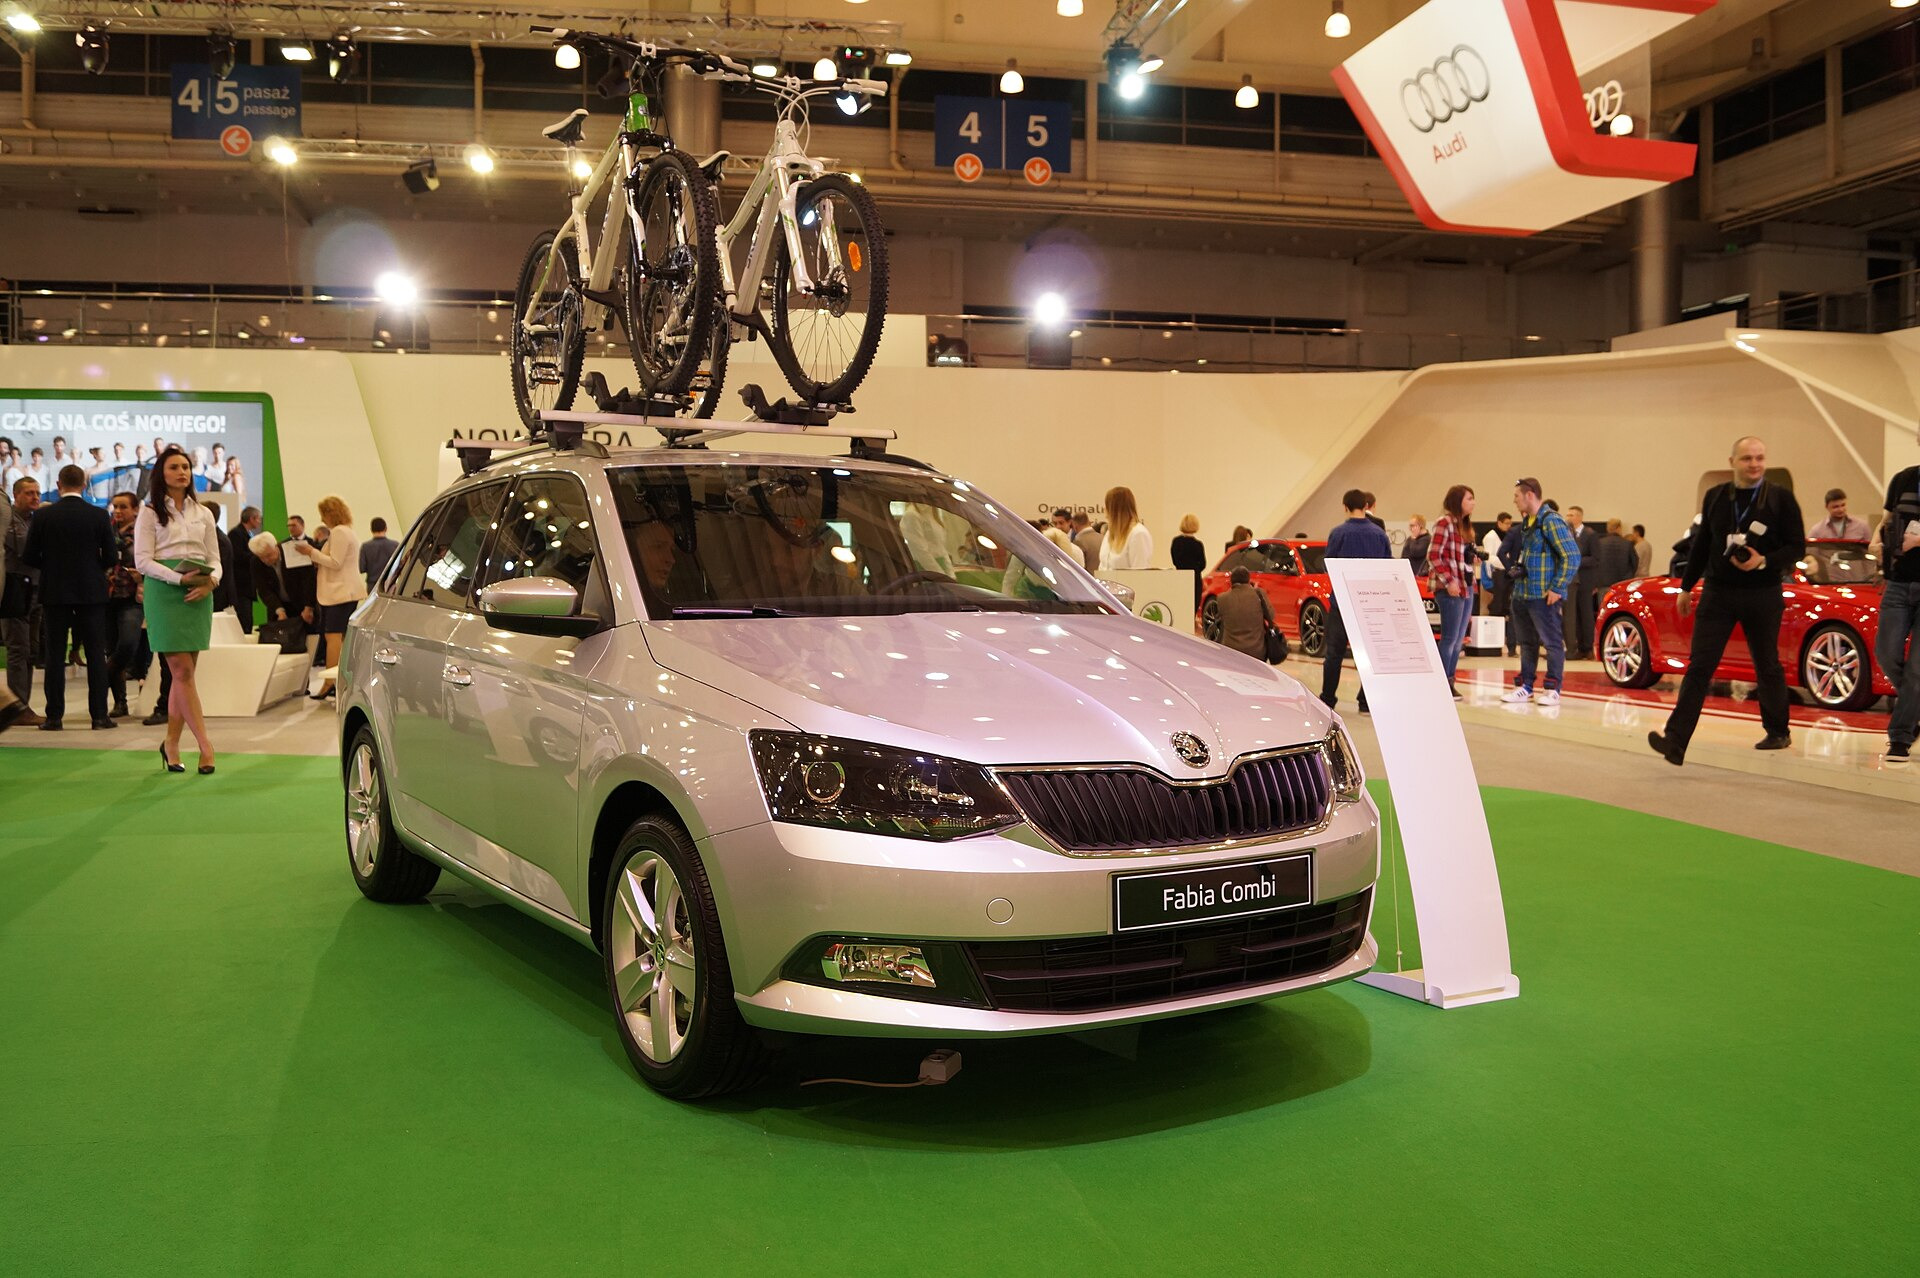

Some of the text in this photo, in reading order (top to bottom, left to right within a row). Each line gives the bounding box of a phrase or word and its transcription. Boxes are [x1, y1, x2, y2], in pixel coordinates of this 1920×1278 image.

[178, 79, 290, 115] 4 5 pasaż
[243, 104, 296, 119] passage
[959, 111, 1048, 147] 4 5
[1432, 130, 1468, 164] Audi
[1, 410, 226, 434] CZAS NA COŚ NOWEGO!
[1163, 874, 1276, 911] Fabia Combi
